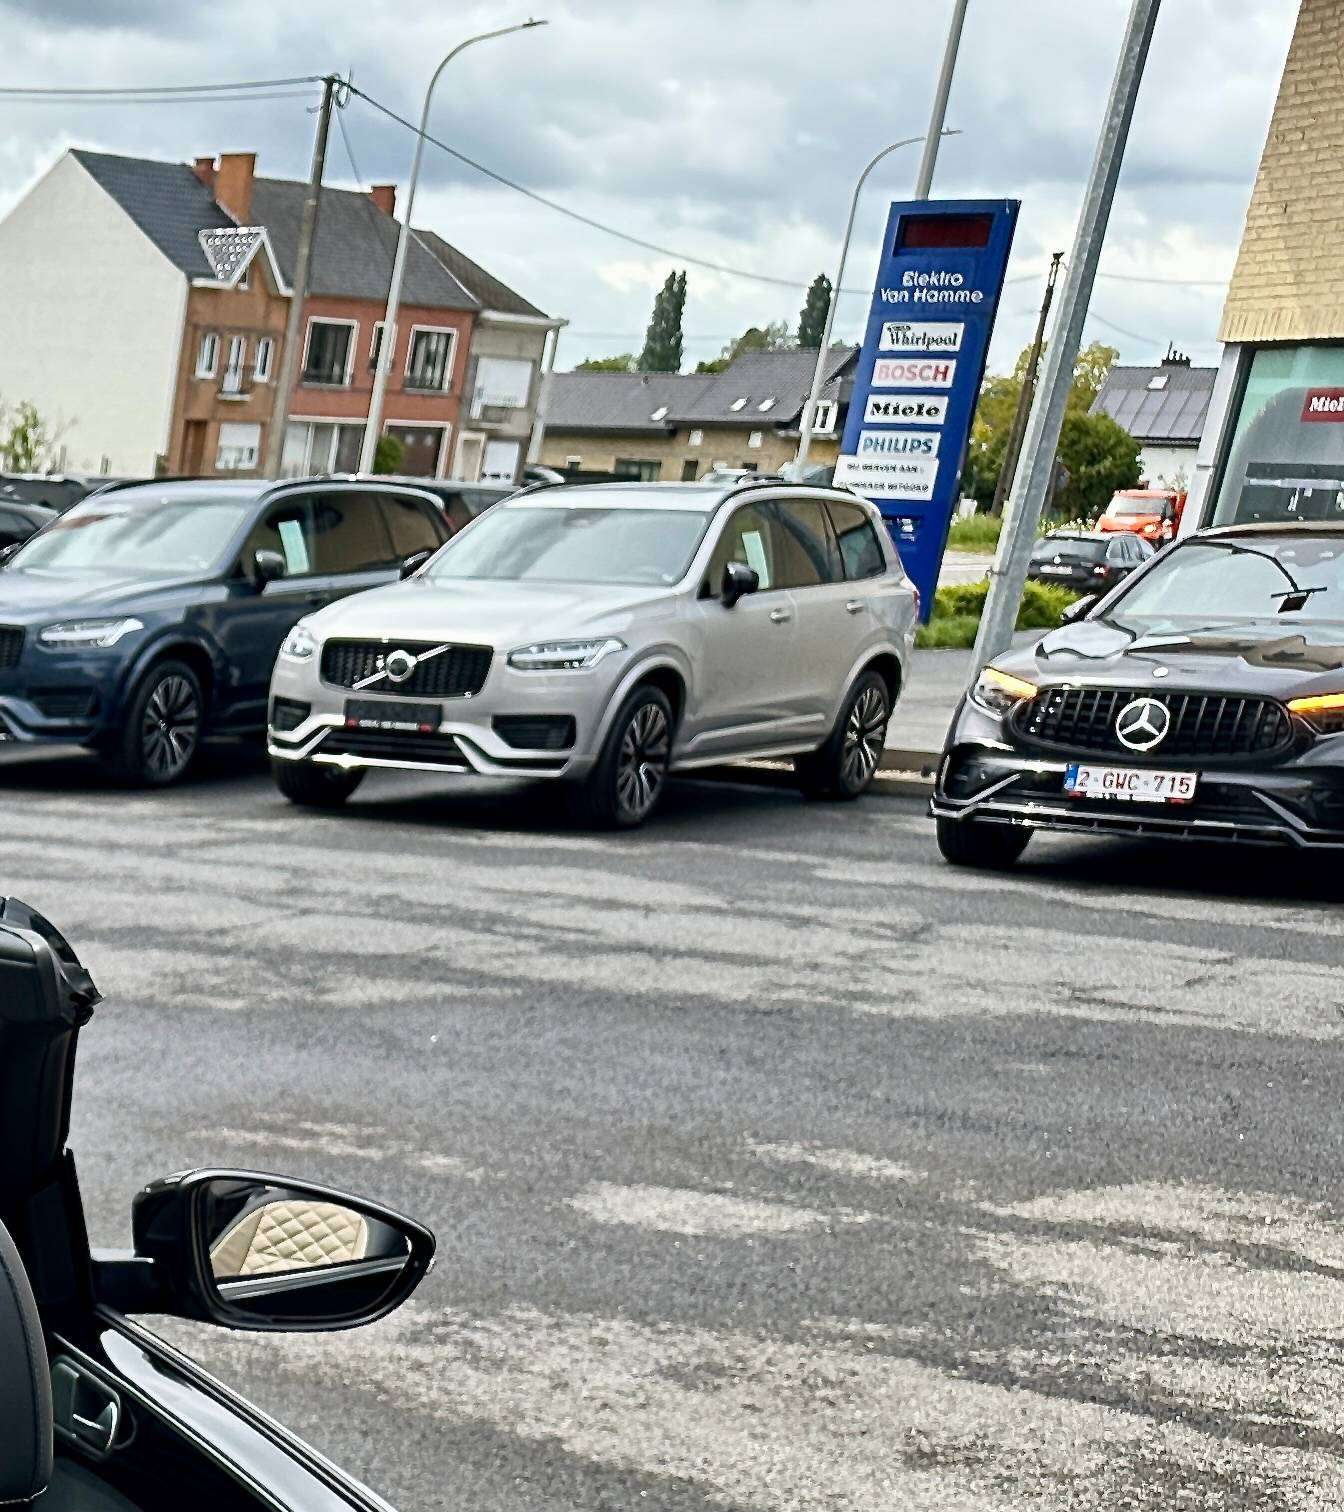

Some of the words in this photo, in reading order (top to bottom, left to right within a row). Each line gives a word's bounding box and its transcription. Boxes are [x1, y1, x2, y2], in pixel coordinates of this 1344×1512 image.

[902, 270, 964, 287] Elektro
[881, 287, 909, 304] Van
[914, 287, 984, 304] Hamme
[888, 330, 958, 351] Whirlpool
[877, 364, 950, 382] BOSCH
[870, 402, 941, 418] Miele
[862, 436, 934, 455] PHILIPS
